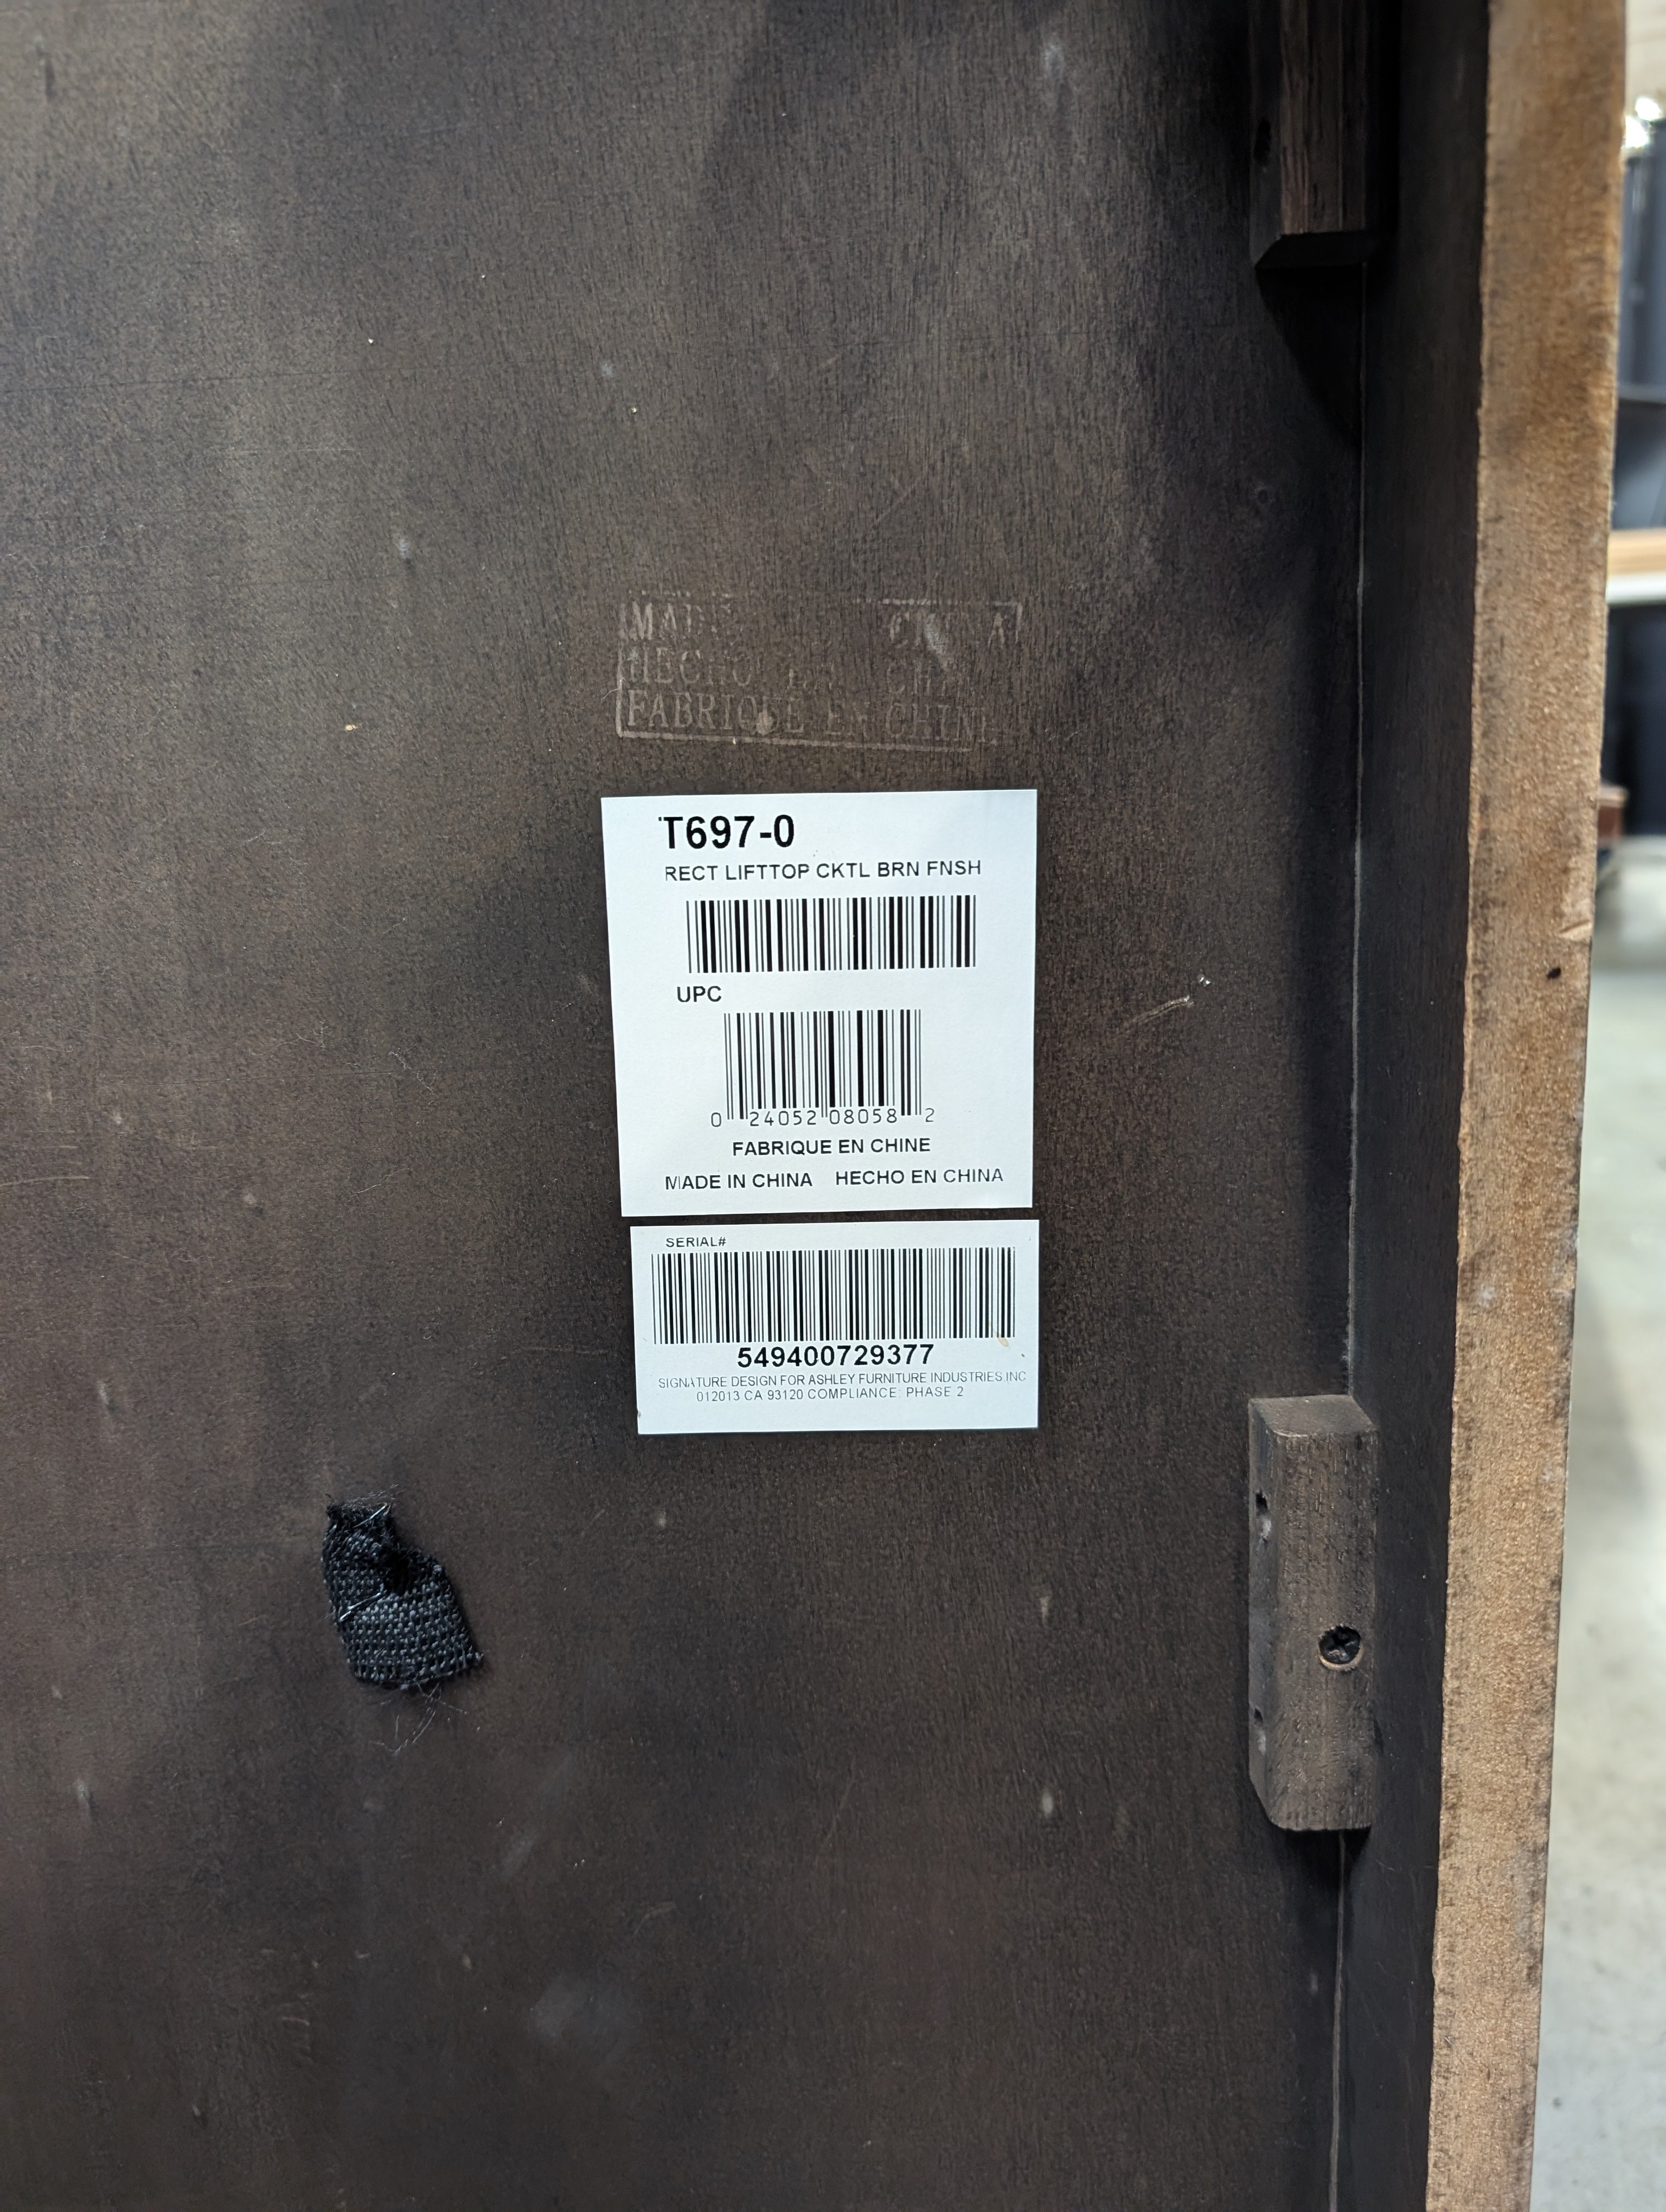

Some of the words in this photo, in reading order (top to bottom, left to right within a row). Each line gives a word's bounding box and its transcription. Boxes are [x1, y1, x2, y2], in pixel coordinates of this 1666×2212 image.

[658, 814, 794, 849] T697-0
[665, 865, 719, 882] RECT
[725, 863, 810, 880] LIFTTOP
[816, 862, 871, 879] CKTL
[877, 860, 920, 878] BRN
[927, 859, 981, 876] FNSH
[676, 985, 722, 1003] UPC
[710, 1112, 722, 1128] 0
[749, 1110, 817, 1127] 24052
[829, 1108, 898, 1125] 08058
[925, 1107, 935, 1123] 2
[732, 1139, 832, 1156] FABRIQUE
[838, 1139, 864, 1154] EN
[870, 1137, 931, 1154] CHINE
[665, 1174, 721, 1190] MADE
[727, 1174, 746, 1189] IN
[752, 1172, 813, 1188] CHINA
[836, 1169, 905, 1186] HECHO
[911, 1169, 937, 1184] EN
[943, 1168, 1004, 1183] CHINA
[665, 1237, 726, 1249] SERIAL#
[737, 1343, 934, 1368] 549400729377
[658, 1376, 728, 1388] SIGNATURE
[731, 1375, 777, 1387] DESIGN
[780, 1374, 805, 1386] FOR
[808, 1373, 856, 1386] ASHLEY
[858, 1372, 927, 1384] FURNITURE
[696, 1390, 740, 1402] 012013
[744, 1390, 763, 1401] CA
[767, 1388, 804, 1400] 93120
[906, 1386, 952, 1398] PHASE
[957, 1386, 964, 1397] 2
